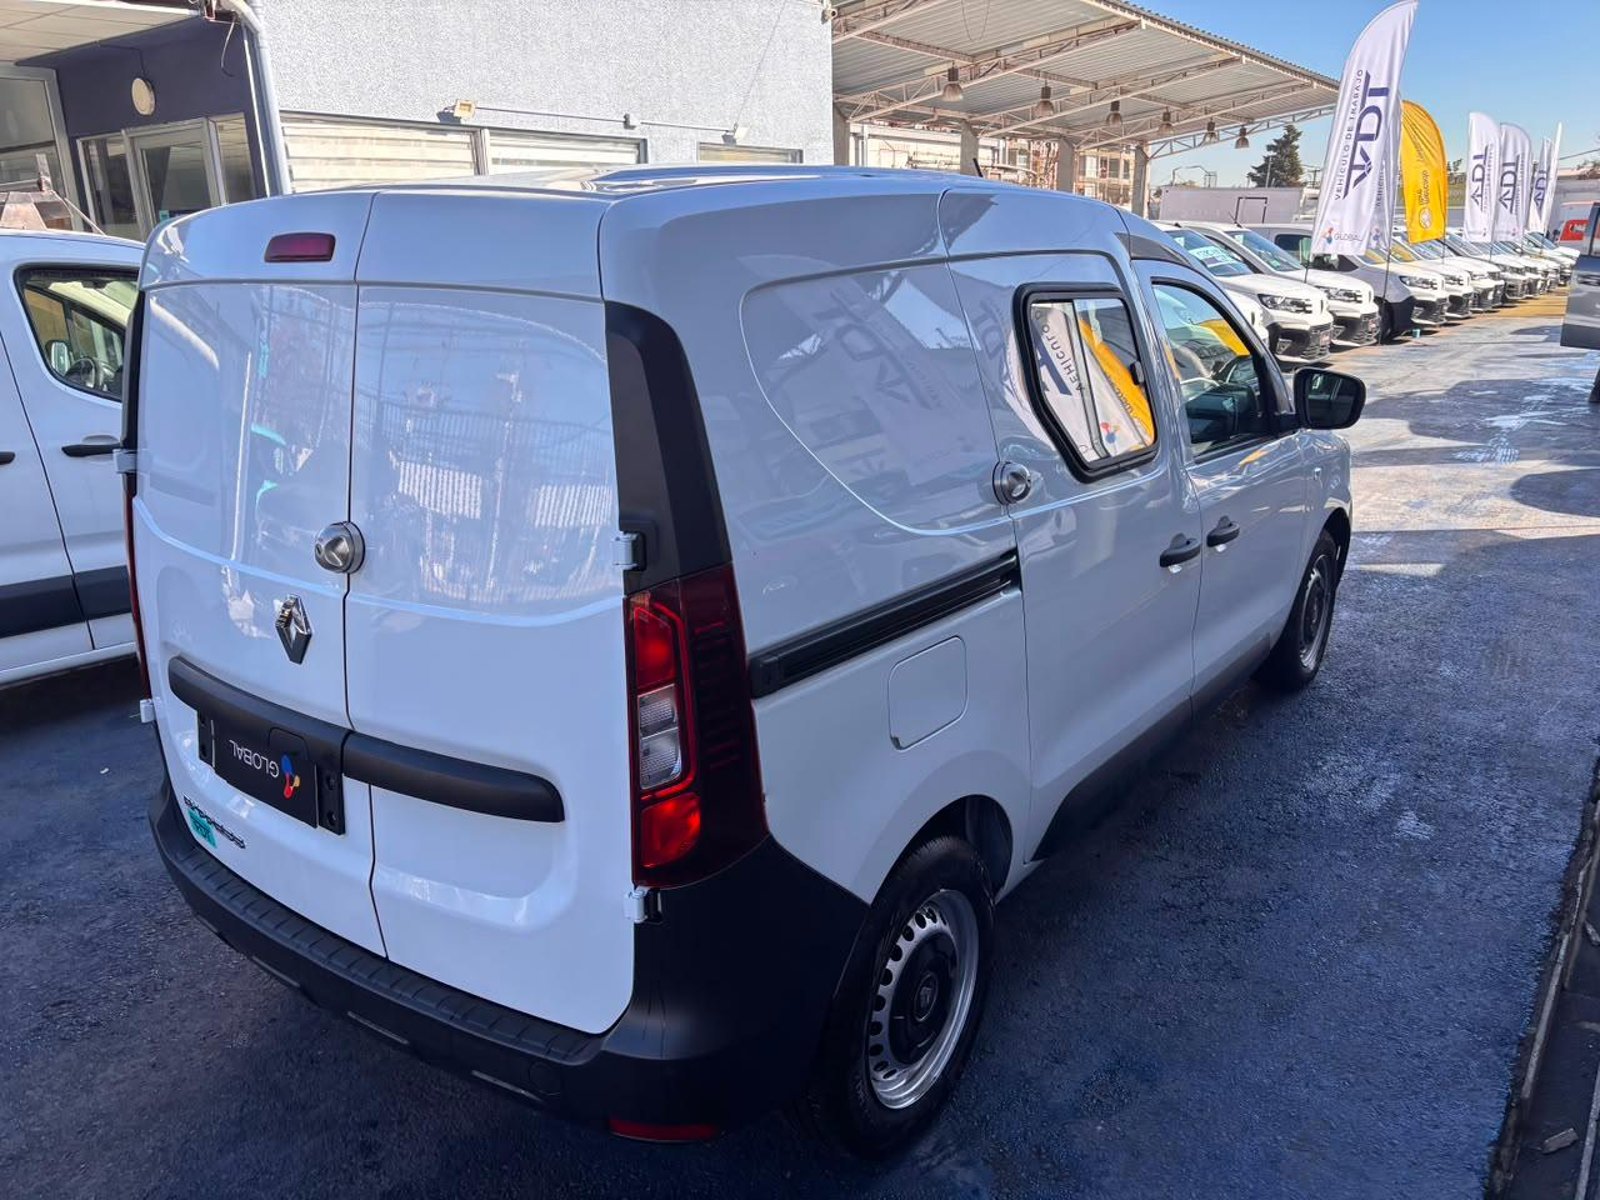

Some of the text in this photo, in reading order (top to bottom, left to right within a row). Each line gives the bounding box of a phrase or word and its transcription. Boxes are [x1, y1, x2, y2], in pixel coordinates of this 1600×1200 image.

[1349, 69, 1363, 120] TRABAJO
[1345, 126, 1354, 141] DE
[229, 739, 280, 778] GLOBAL
